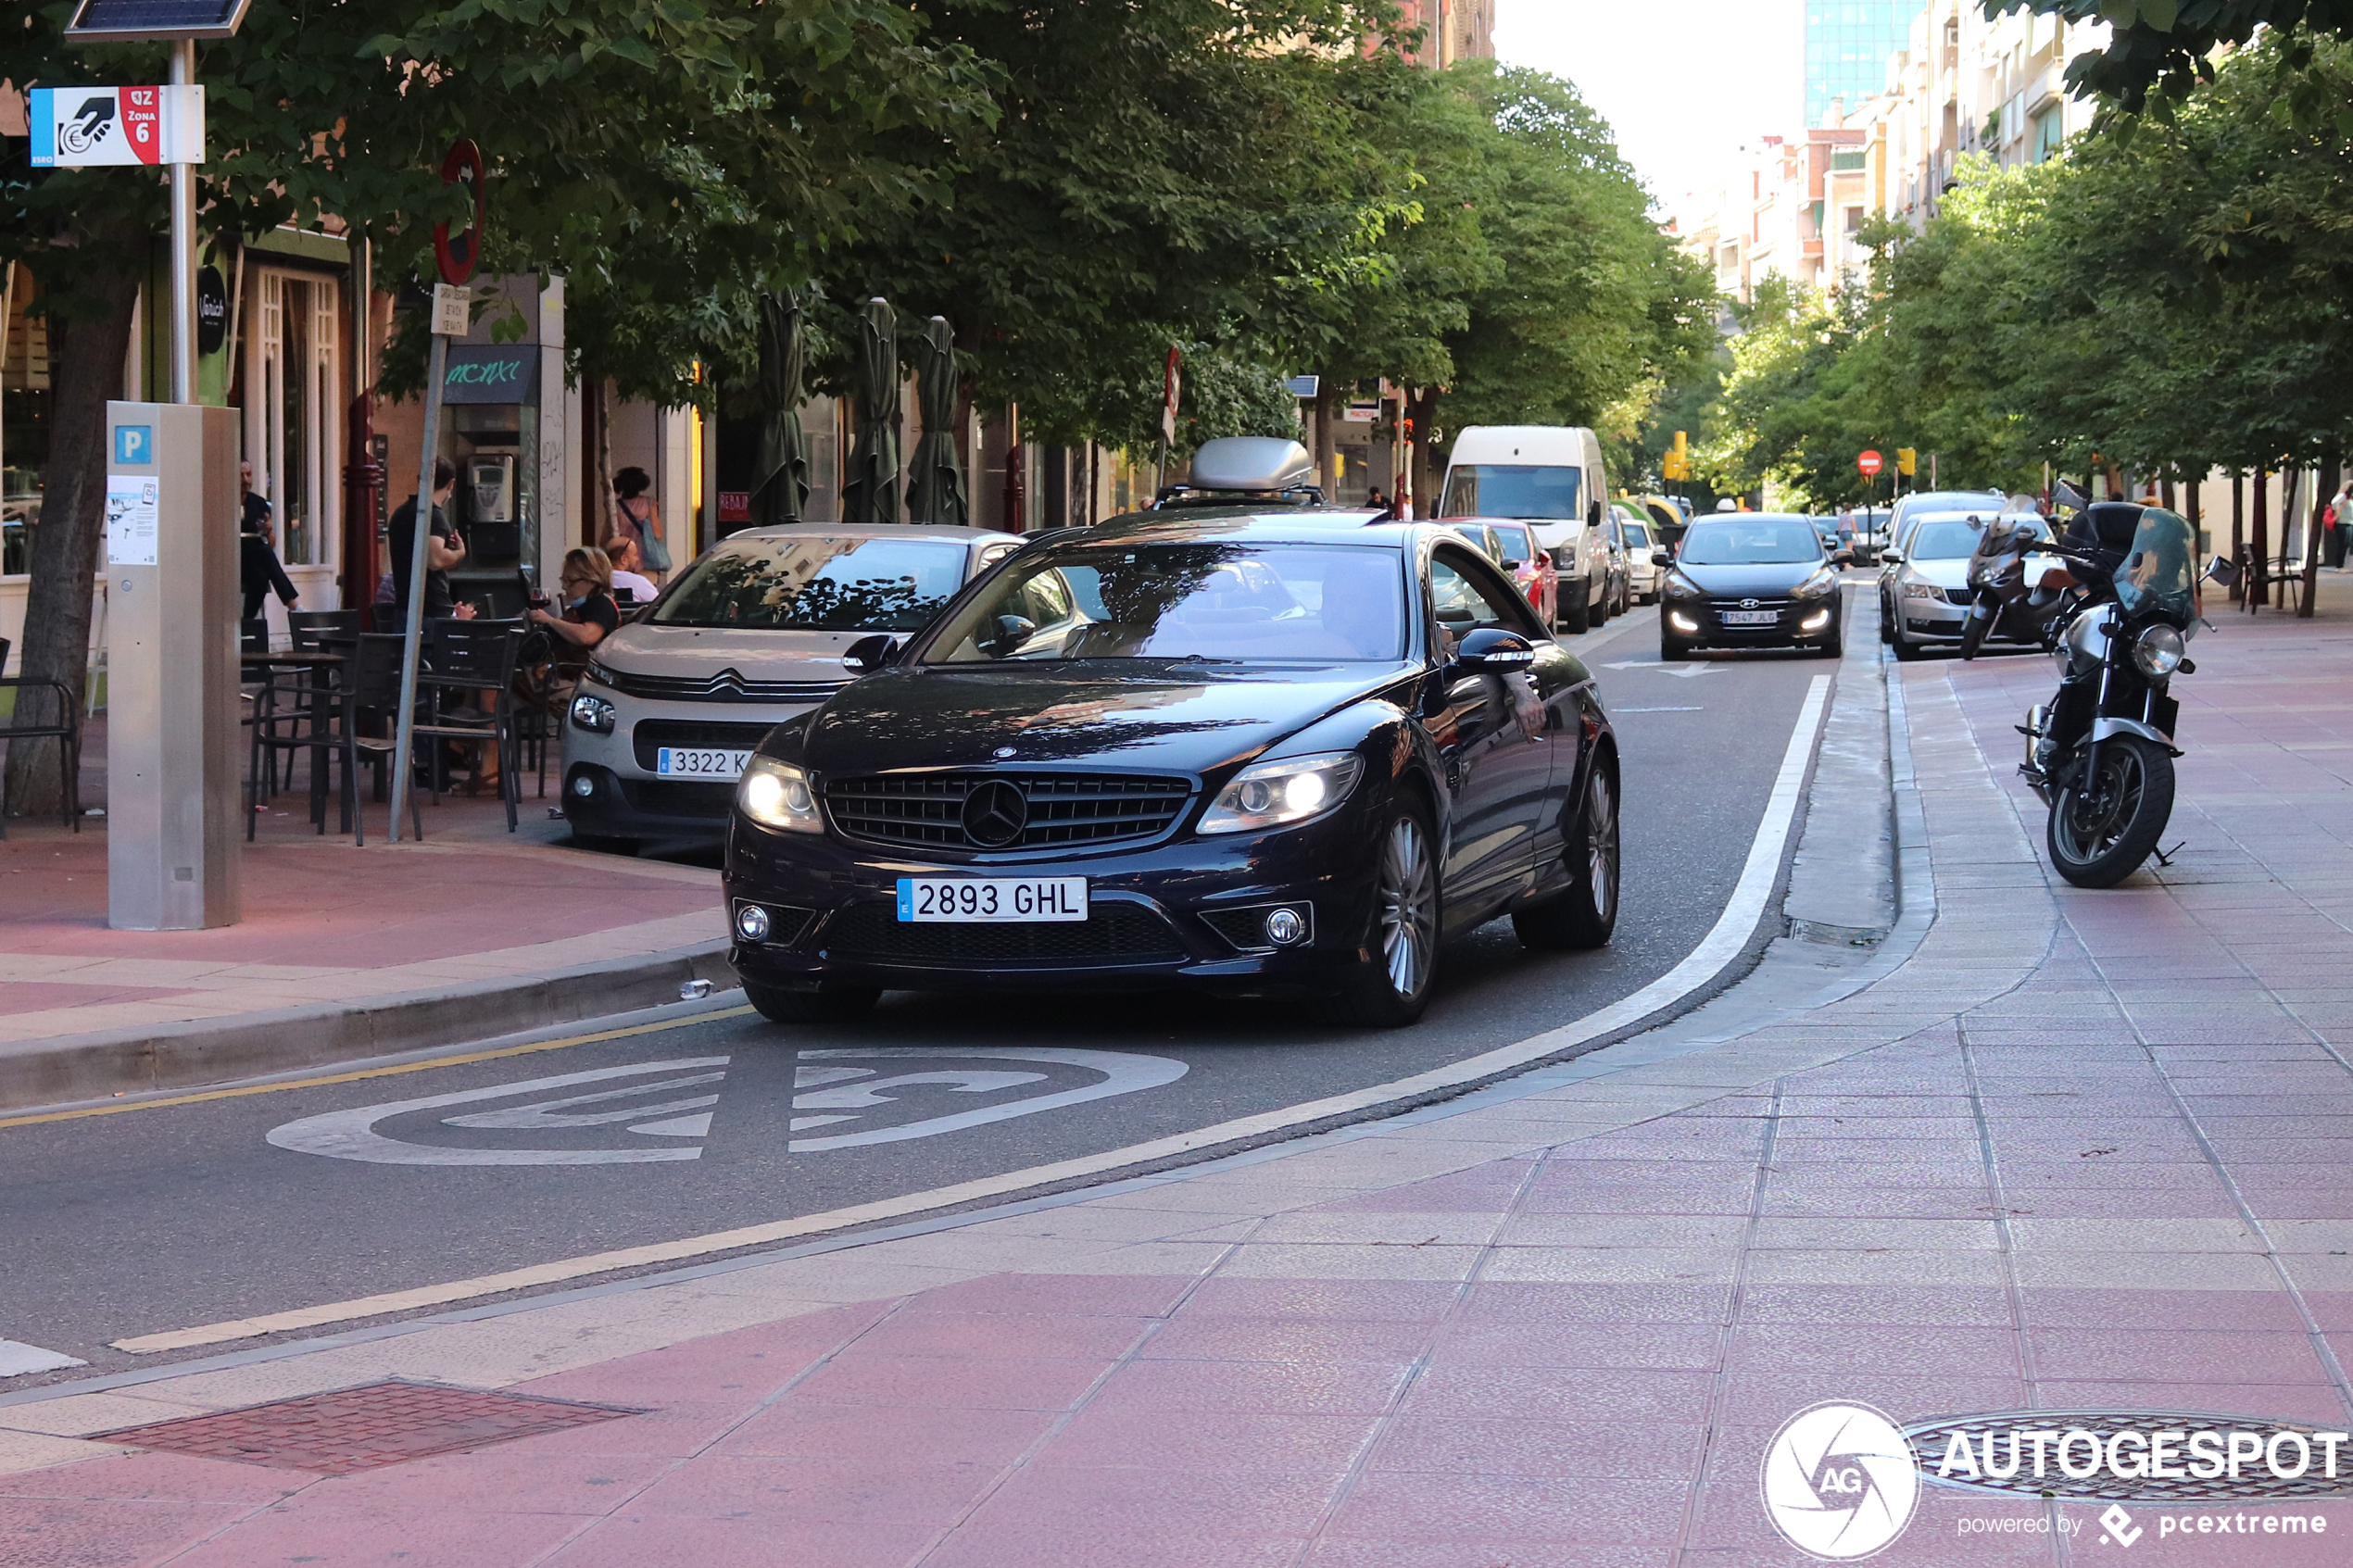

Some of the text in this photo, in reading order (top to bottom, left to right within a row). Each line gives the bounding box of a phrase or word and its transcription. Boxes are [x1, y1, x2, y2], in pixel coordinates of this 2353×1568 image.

[135, 122, 150, 143] 6
[125, 431, 143, 458] P
[1729, 613, 1753, 621] 7547
[675, 751, 747, 773] 3322 K
[918, 883, 1079, 915] 2893 GHL
